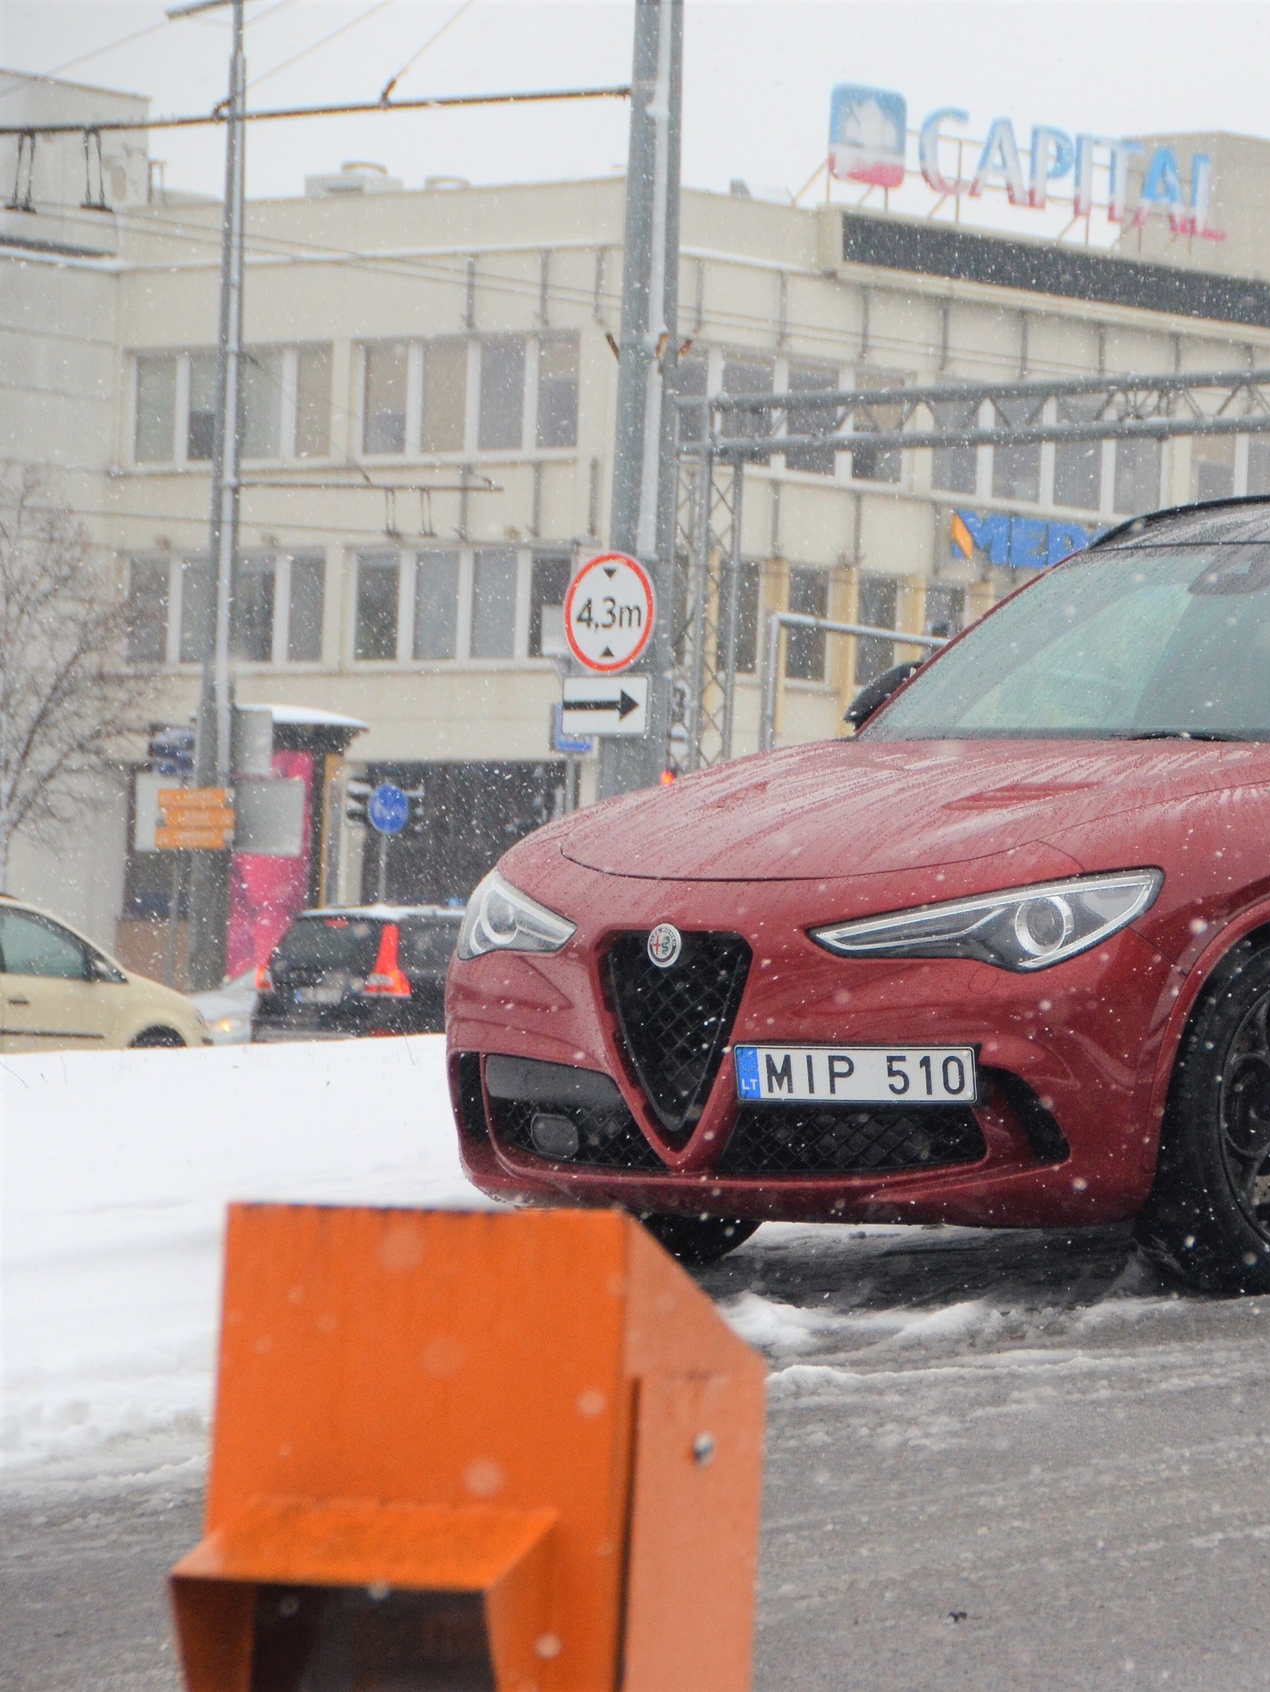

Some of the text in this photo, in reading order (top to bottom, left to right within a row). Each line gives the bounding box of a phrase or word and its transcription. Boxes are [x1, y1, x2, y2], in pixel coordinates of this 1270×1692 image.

[919, 106, 1227, 242] CAPITAL
[575, 596, 642, 633] 4,3m
[741, 1078, 758, 1091] LT
[765, 1053, 965, 1096] MIP 510
